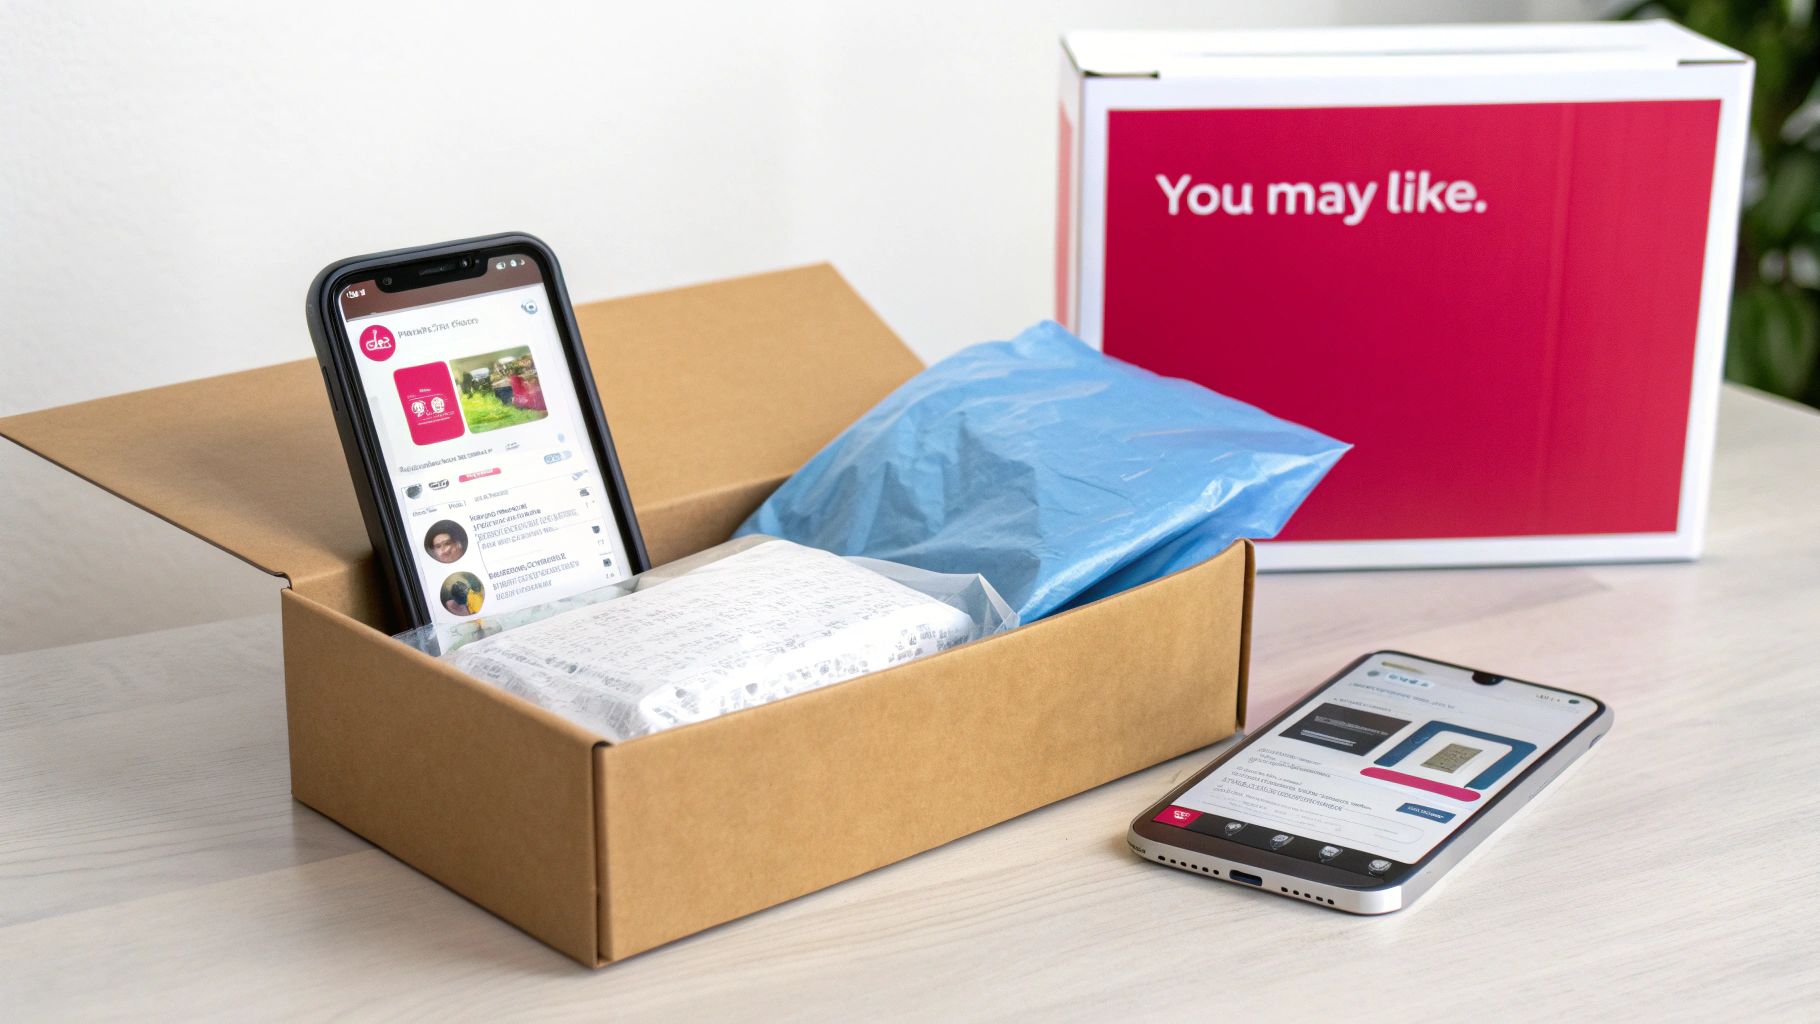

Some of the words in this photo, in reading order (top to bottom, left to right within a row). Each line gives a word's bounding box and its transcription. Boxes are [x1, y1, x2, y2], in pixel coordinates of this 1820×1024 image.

[1155, 174, 1254, 216] You
[1267, 181, 1379, 226] may
[1386, 169, 1488, 214] like.
